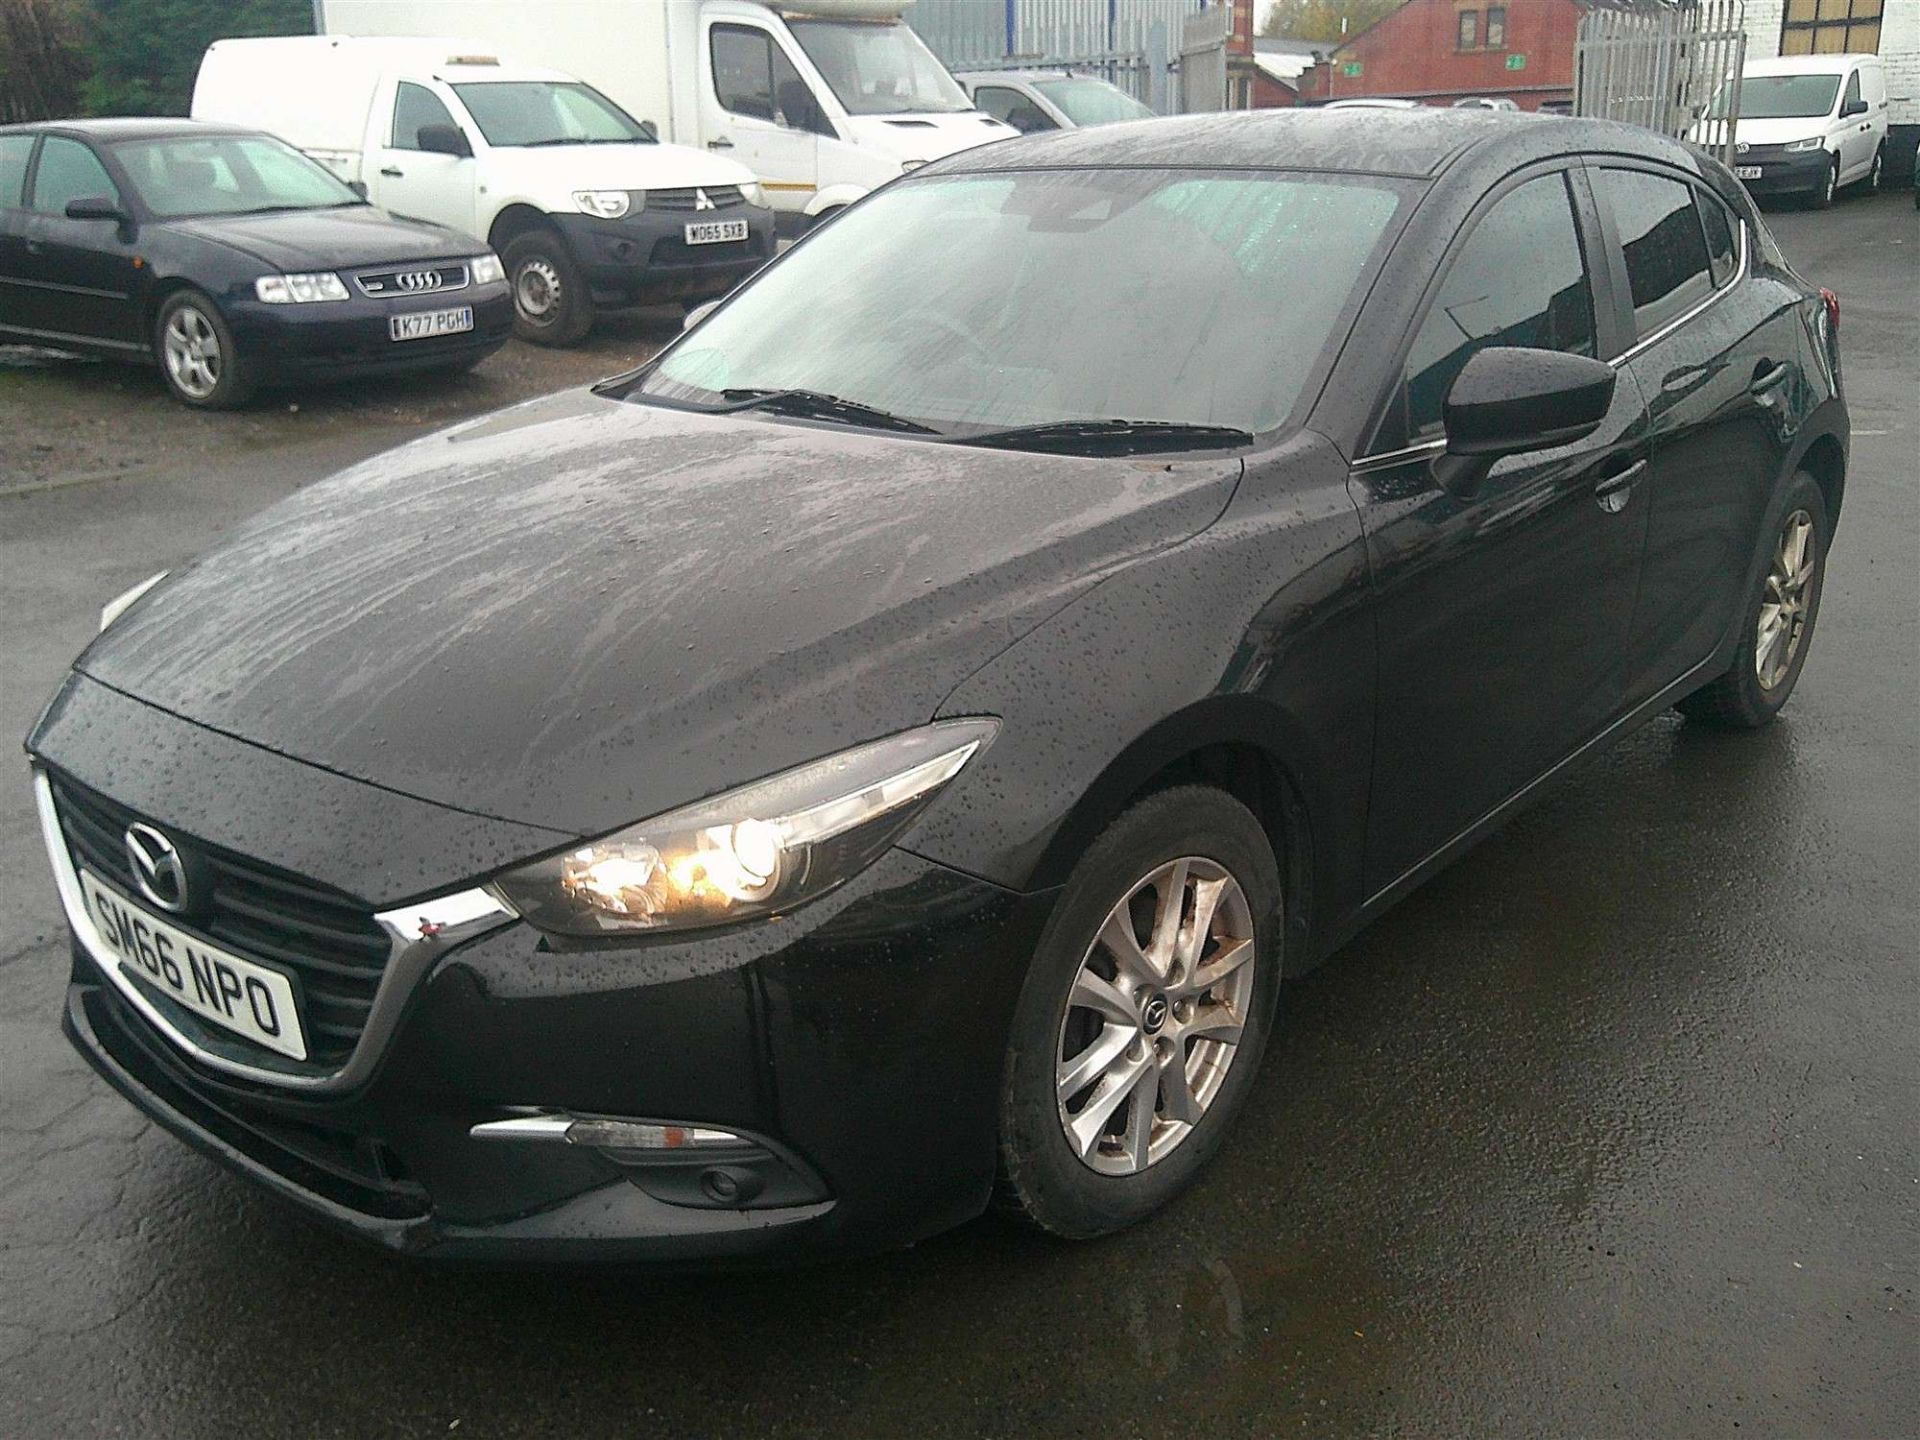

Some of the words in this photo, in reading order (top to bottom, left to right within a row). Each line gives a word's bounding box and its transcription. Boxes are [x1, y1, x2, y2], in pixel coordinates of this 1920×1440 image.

[402, 316, 432, 337] K77
[95, 889, 184, 991] SM66
[186, 946, 280, 1037] NPO
